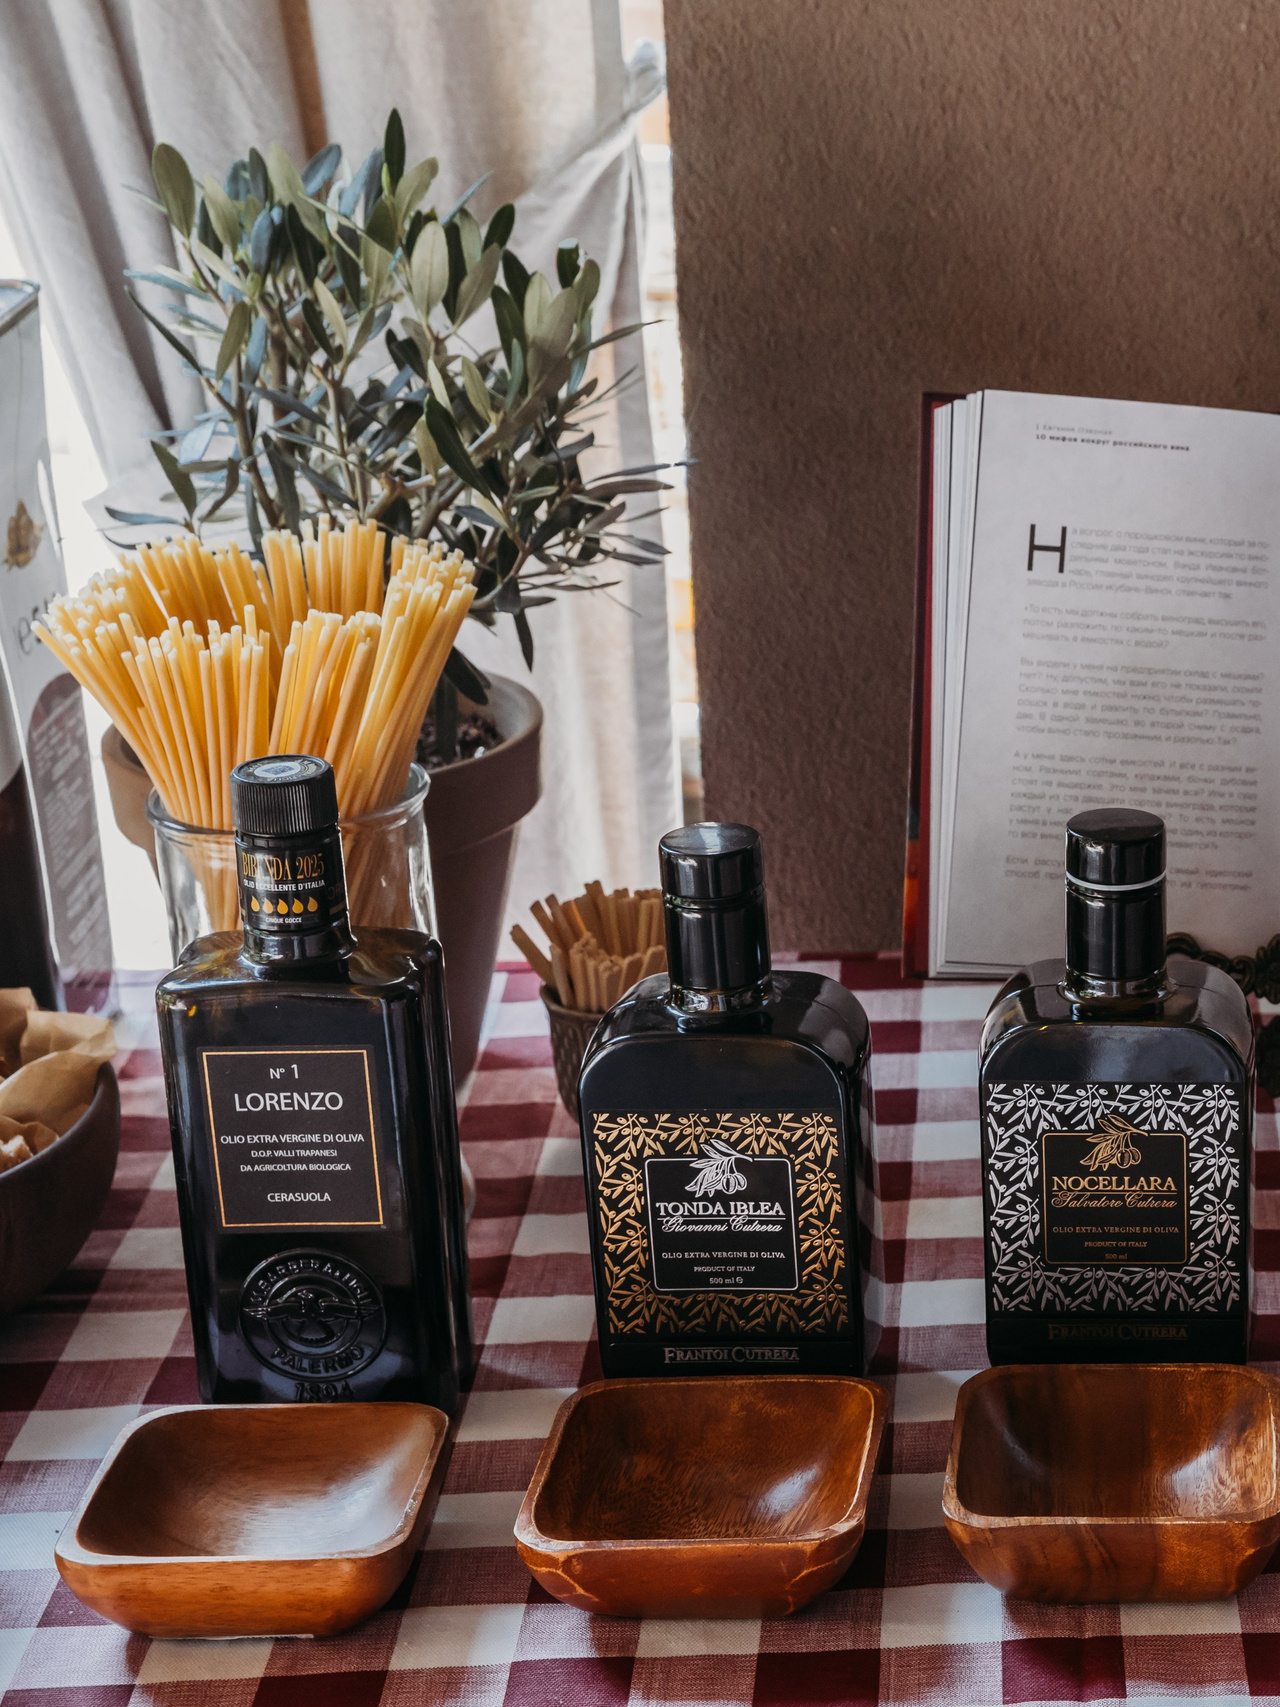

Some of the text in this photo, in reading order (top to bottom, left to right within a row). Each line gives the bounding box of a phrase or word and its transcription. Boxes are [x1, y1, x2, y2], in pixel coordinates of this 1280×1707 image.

[296, 853, 325, 879] 2025
[243, 879, 325, 891] OLIO ECCELLENTE D'ITALIA
[291, 1064, 299, 1079] 1
[234, 1092, 344, 1112] LORENZO
[220, 1134, 364, 1144] OLIO EXTRA VERGINE DI OLIVA
[1052, 1176, 1177, 1191] NOCELLARA
[267, 1192, 331, 1202] CERASUOLA
[1051, 1191, 1177, 1208] Salvatore Cutrera
[656, 1202, 786, 1216] TONDA IBLEA
[661, 1215, 783, 1233] Giovanni Cutrera
[1047, 1324, 1188, 1340] FRANTOI CUTRERA
[271, 1344, 365, 1374] PALERMO
[664, 1348, 799, 1363] FRANTOI CUTRERA
